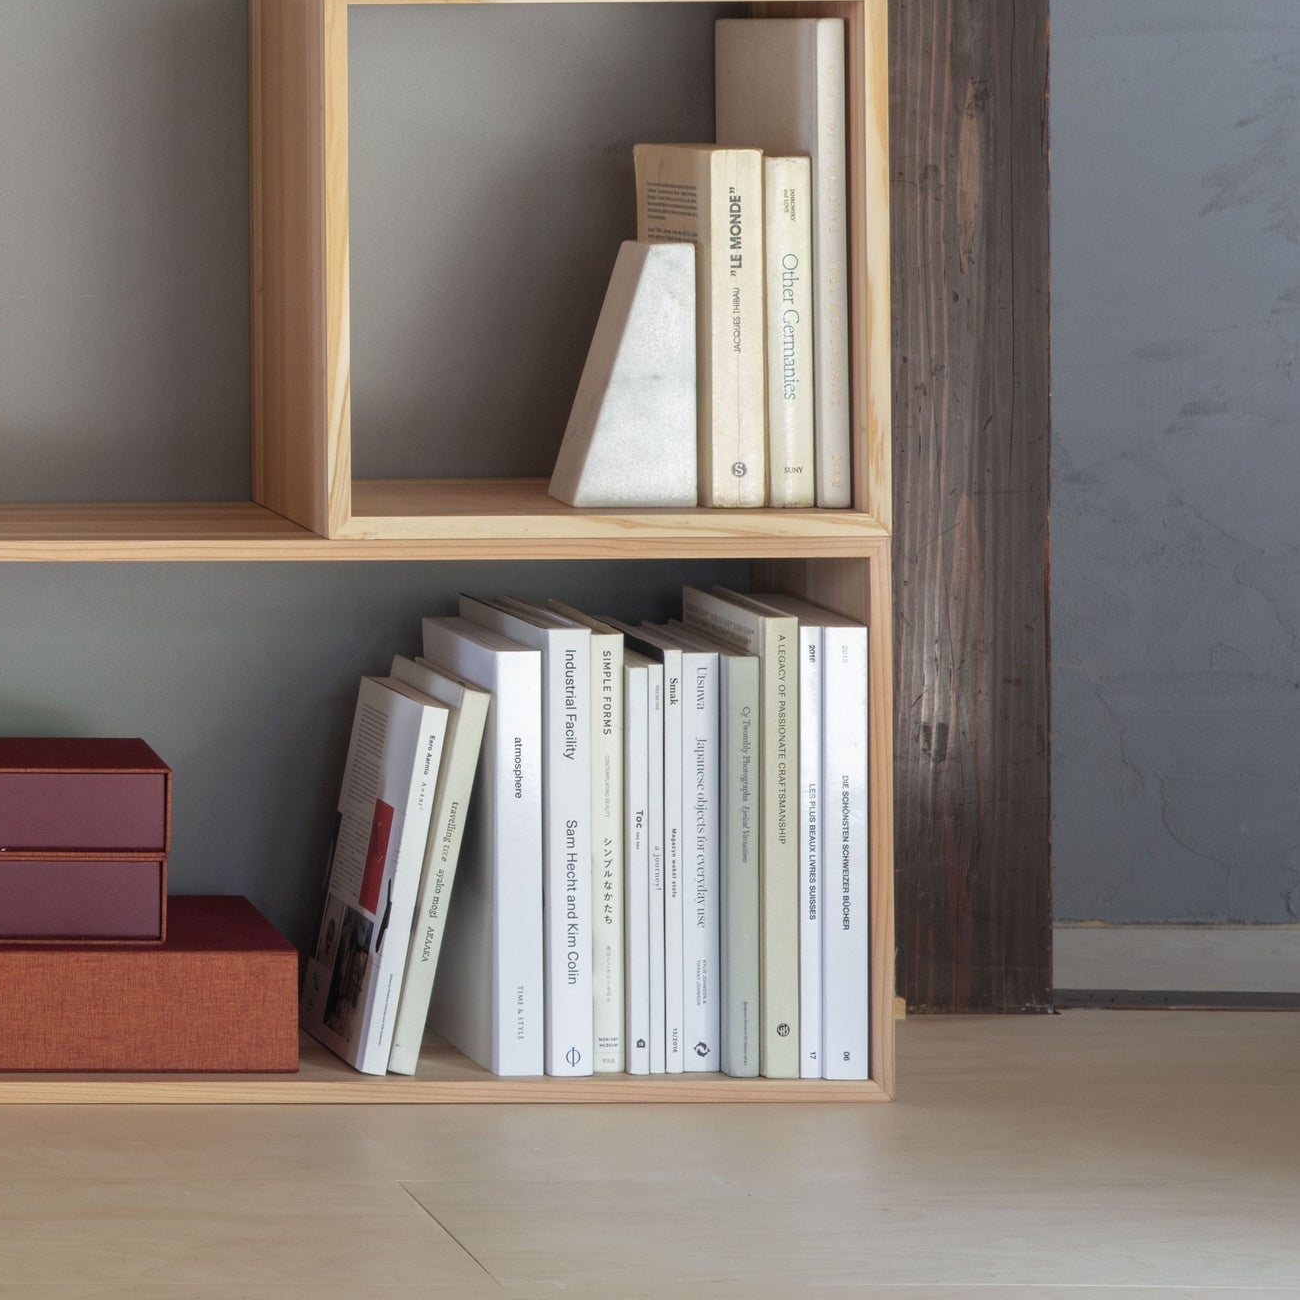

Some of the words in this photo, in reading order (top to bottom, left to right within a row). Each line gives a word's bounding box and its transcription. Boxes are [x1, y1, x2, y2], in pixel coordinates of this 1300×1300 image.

[782, 253, 799, 305] Other
[732, 287, 741, 314] THIBAU
[732, 316, 741, 354] JACQUES
[782, 309, 800, 401] Germanies
[784, 466, 803, 474] SUNY
[778, 634, 786, 642] A
[603, 650, 612, 692] SIMPLE
[778, 644, 786, 682] LEGACY
[565, 649, 577, 711] Industrial
[669, 677, 679, 706] Smak
[696, 667, 708, 711] Utsuwa
[778, 684, 786, 698] OF
[603, 696, 612, 736] FORMS
[740, 706, 750, 718] Cy
[427, 735, 436, 751] Eero
[563, 713, 577, 761] Facility
[740, 720, 751, 754] Twombly
[778, 700, 786, 760] PASSIONATE
[423, 752, 433, 776] Aarnio
[513, 737, 524, 799] atmosphere
[693, 737, 708, 791] Japanese
[740, 755, 751, 802] Photographs
[808, 783, 816, 800] LES
[841, 775, 849, 789] DIE
[636, 810, 644, 829] Toc
[694, 792, 708, 834] objects
[740, 805, 750, 829] Lyrical
[778, 762, 787, 845] CRAFTSMANSHIP
[808, 801, 816, 823] PLUS
[841, 790, 850, 843] SCHÖNSTEN
[442, 801, 459, 843] travelling
[566, 819, 578, 849] Sam
[441, 845, 450, 862] tree
[696, 836, 708, 851] for
[742, 830, 750, 864] Variations
[808, 825, 816, 853] BEAUX
[434, 869, 445, 894] ayako
[566, 852, 578, 892] Hecht
[603, 837, 613, 925] シンプルなかたち
[652, 853, 662, 891] journey!
[694, 853, 708, 905] everyday
[808, 855, 816, 883] LIVRES
[842, 844, 850, 894] SCHWEIZER
[429, 896, 441, 919] mogi
[567, 894, 579, 920] and
[696, 908, 706, 929] use
[842, 895, 851, 931] BÜCHER
[421, 926, 435, 963] AKAAKA
[567, 923, 579, 948] Kim
[567, 951, 579, 985] Colin
[517, 986, 525, 1006] TIME
[517, 1017, 525, 1041] STYLE
[810, 1051, 817, 1060] 17
[843, 1051, 850, 1062] 06
